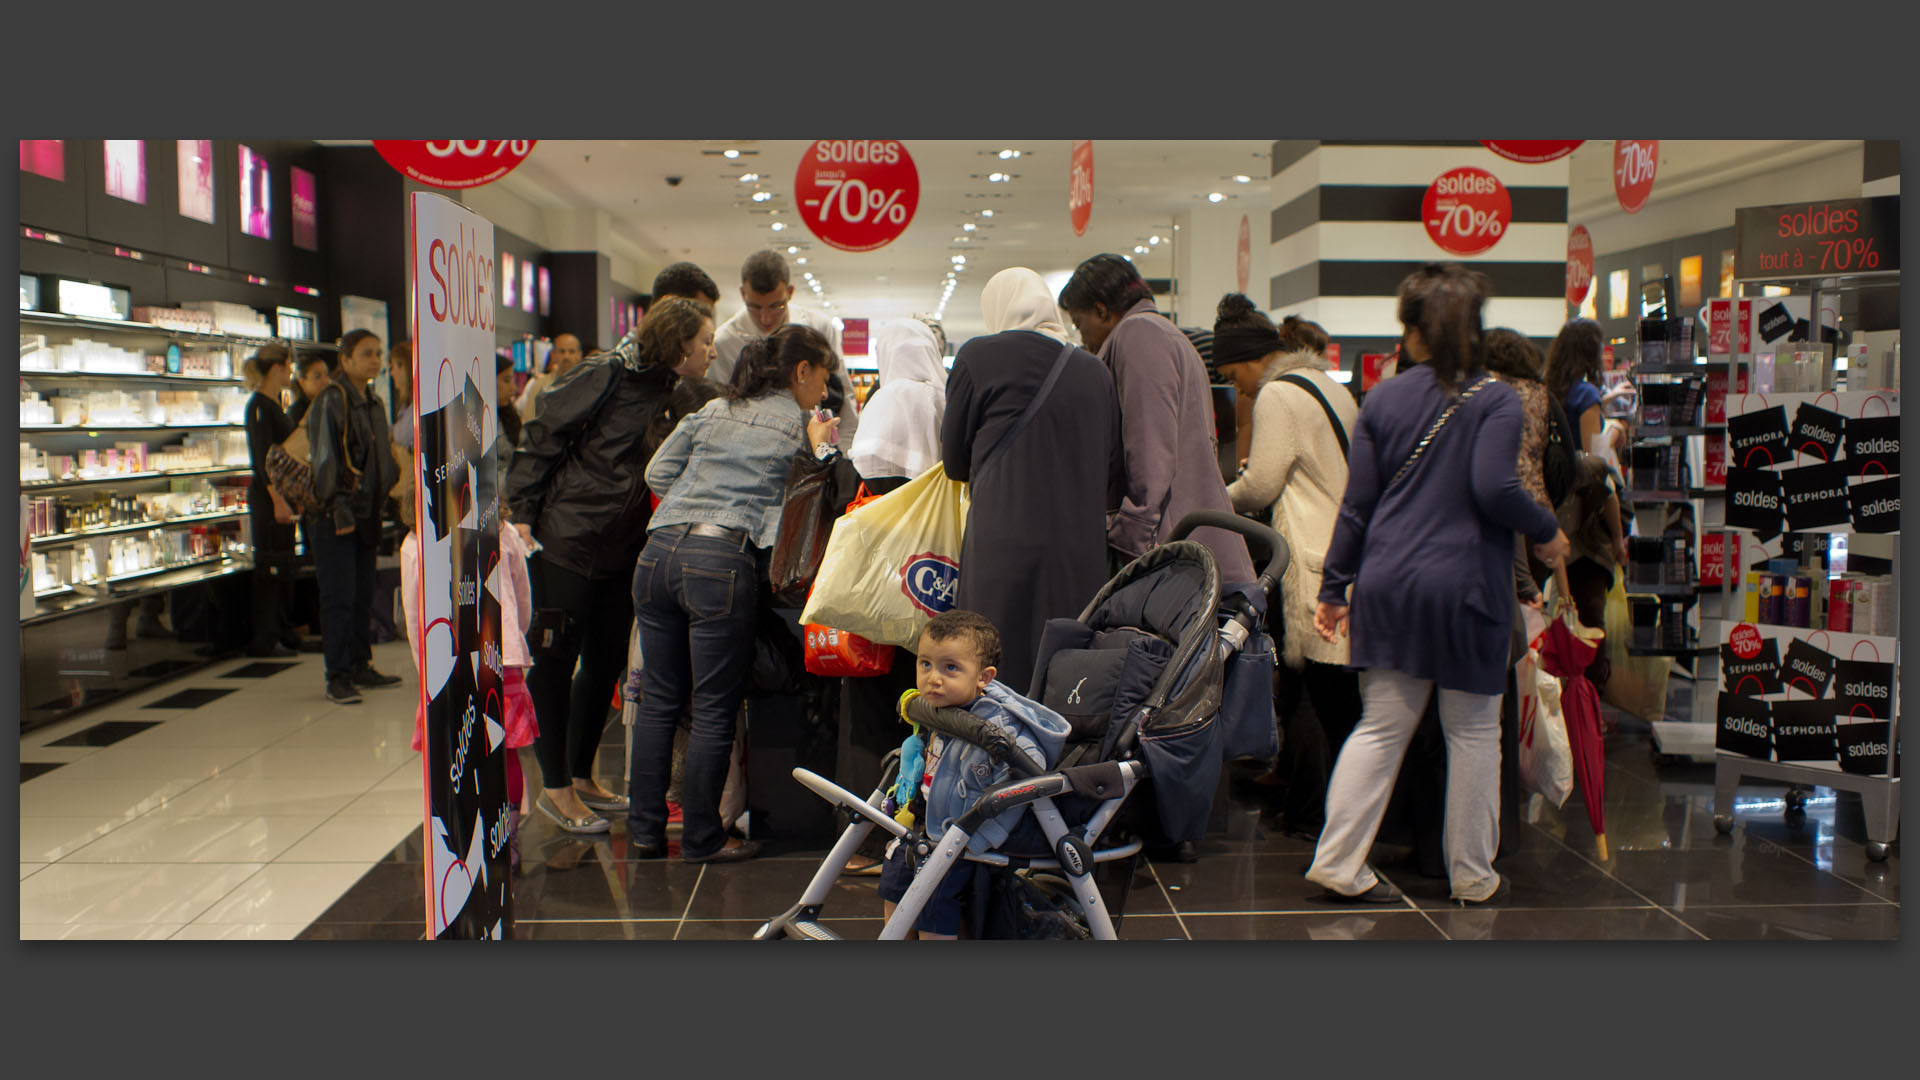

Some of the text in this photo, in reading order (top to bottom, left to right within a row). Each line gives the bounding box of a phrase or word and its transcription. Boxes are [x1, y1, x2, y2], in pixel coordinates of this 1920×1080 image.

[815, 139, 900, 164] soldes
[1616, 142, 1654, 188] -70%
[1436, 172, 1497, 195] soldes
[804, 179, 907, 224] -70%
[1429, 204, 1502, 237] -70%
[1778, 205, 1859, 238] soldes
[1760, 238, 1880, 270] tout à -70%
[428, 221, 495, 333] soldes
[1736, 430, 1784, 449] SEPHORA
[1800, 423, 1837, 445] soldes
[1855, 437, 1899, 455] soldes
[434, 447, 466, 484] SEPHORA
[1734, 488, 1779, 510] soldes
[1790, 486, 1844, 504] SEPHORA
[479, 496, 499, 532] SEPHOR
[1861, 498, 1900, 518] soldes
[458, 574, 476, 606] soldes
[914, 566, 959, 607] C&A
[1729, 662, 1776, 674] SEPHORA
[1791, 658, 1827, 682] soldes
[1845, 682, 1888, 698] soldes
[1724, 716, 1768, 738] soldes
[1779, 725, 1832, 735] SEPHORA
[450, 693, 477, 795] soldes
[1848, 741, 1889, 757] soldes
